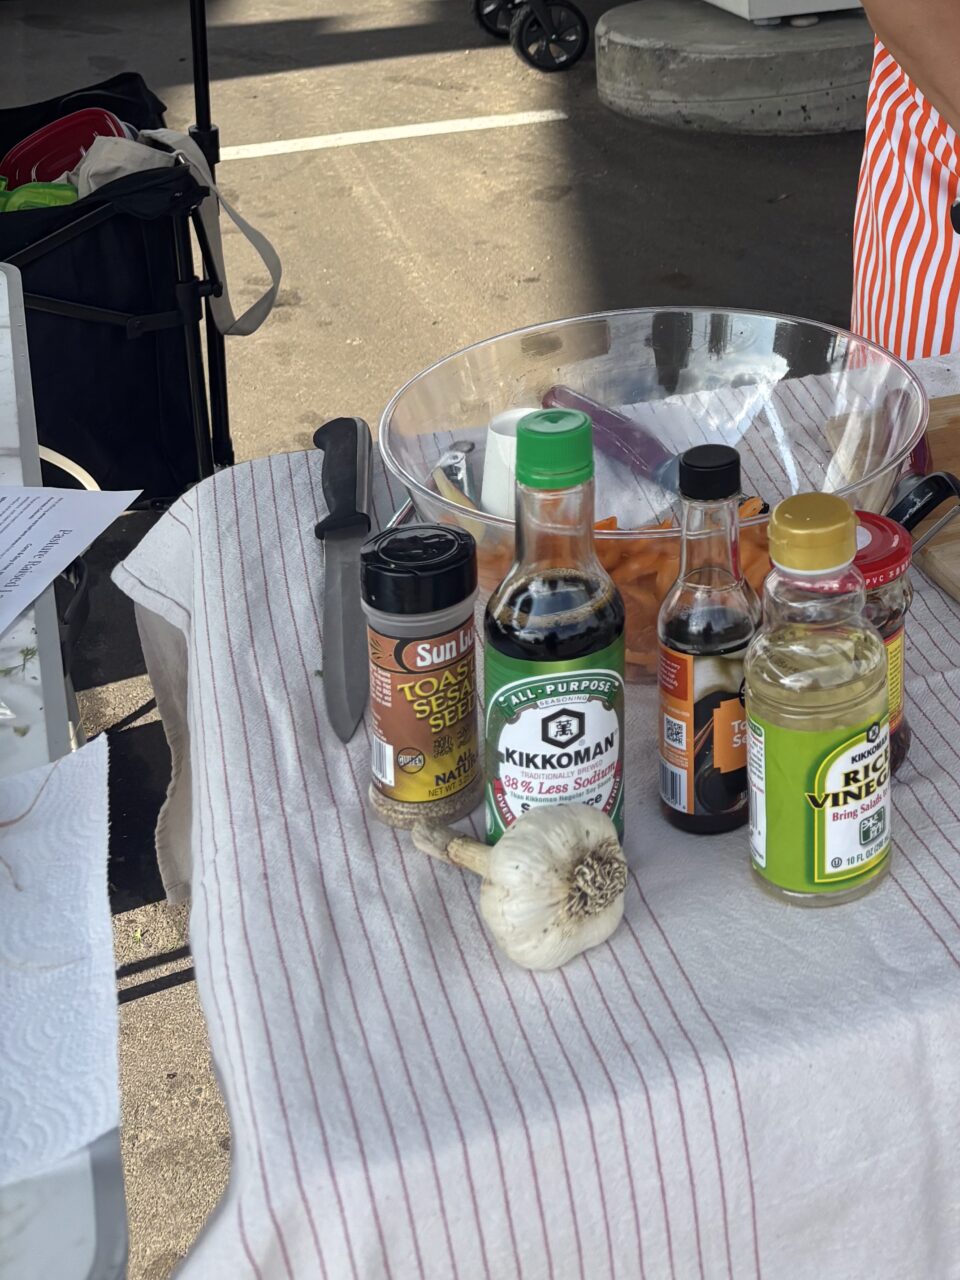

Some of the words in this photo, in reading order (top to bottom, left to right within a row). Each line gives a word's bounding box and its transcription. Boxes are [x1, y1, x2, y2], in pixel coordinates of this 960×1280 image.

[34, 529, 72, 558] Pasture
[4, 560, 42, 587] Raised
[416, 640, 457, 667] Sun
[460, 627, 475, 654] Lu
[539, 695, 588, 706] SEASONING
[505, 732, 614, 770] KIKKOMAN
[521, 771, 574, 780] TRADITIONALLY
[578, 760, 603, 774] BREWED
[538, 782, 568, 794] Less
[574, 762, 615, 790] Sodium
[428, 785, 443, 798] NET
[496, 794, 513, 821] OVER
[832, 806, 859, 822] Bring
[860, 792, 882, 814] Salads
[847, 855, 855, 866] 10
[856, 851, 864, 864] FL
[865, 846, 874, 860] OZ
